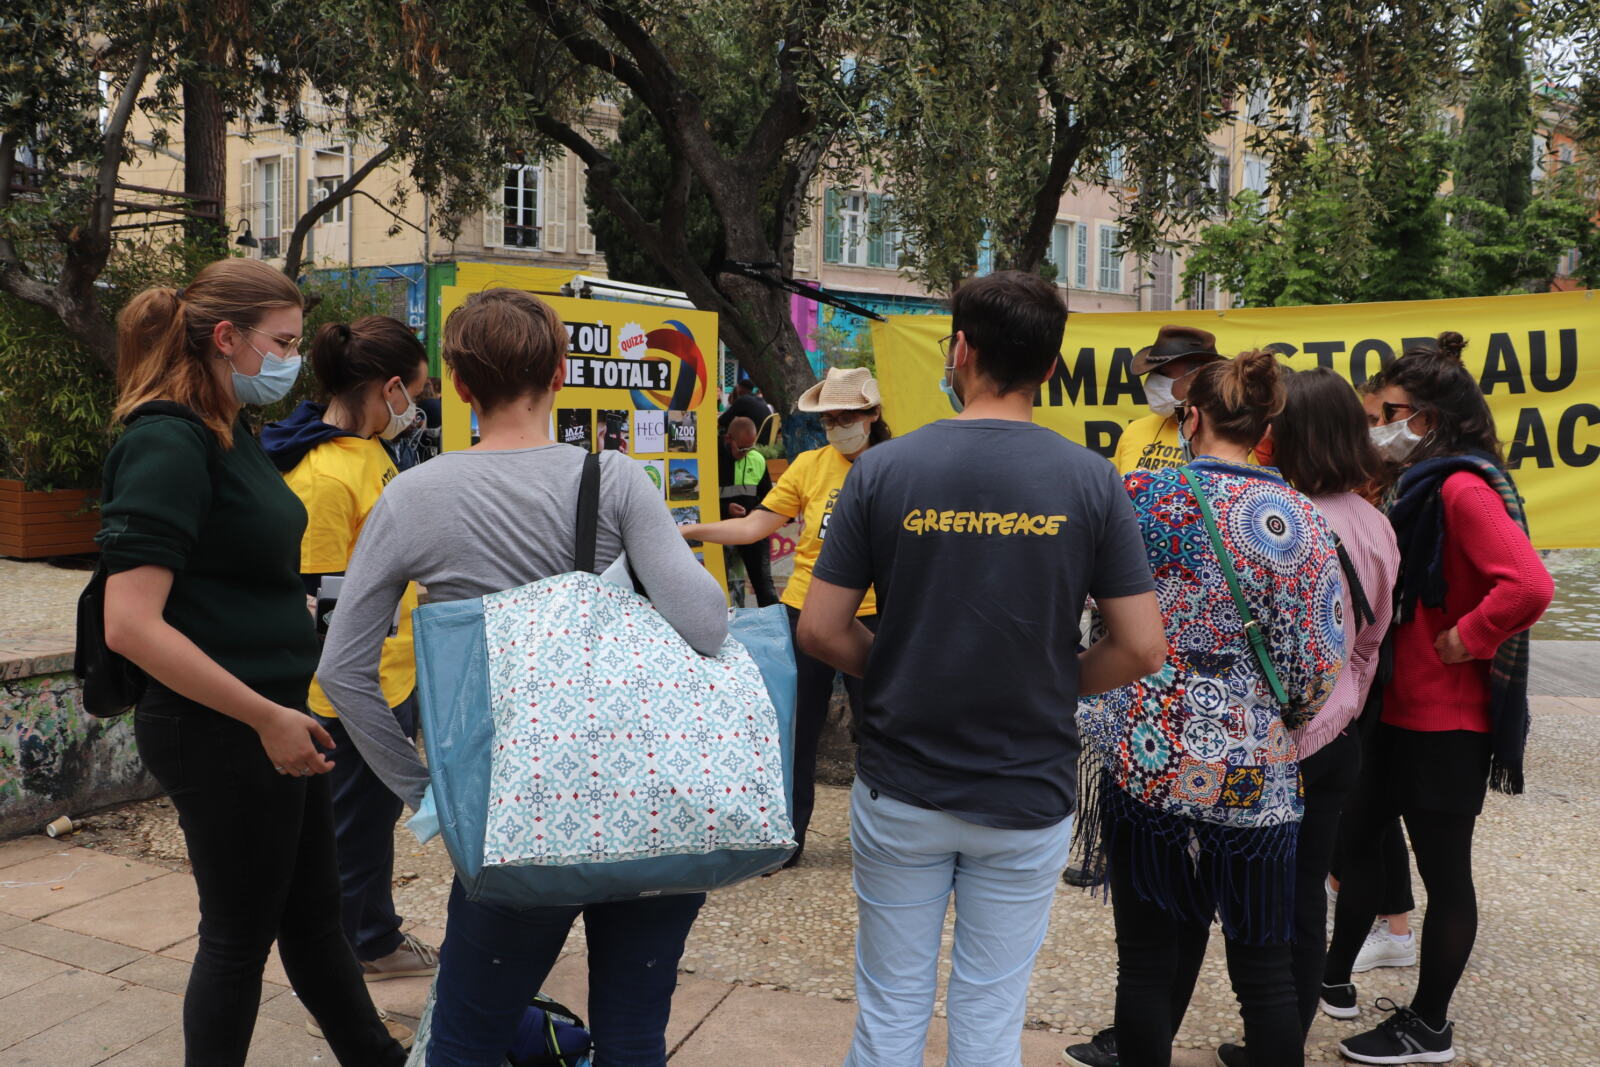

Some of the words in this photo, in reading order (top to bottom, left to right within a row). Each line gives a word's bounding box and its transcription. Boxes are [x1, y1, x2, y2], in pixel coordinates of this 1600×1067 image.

[578, 320, 609, 354] OÙ
[620, 334, 645, 352] QUIZZ
[590, 361, 653, 387] TOTAL
[658, 363, 669, 389] ?
[1033, 347, 1149, 407] MA
[1479, 328, 1578, 395] AU
[565, 425, 585, 438] JAZZ
[637, 420, 664, 437] HEC
[678, 426, 695, 437] ZOO
[903, 508, 1068, 536] GREENPEACE
